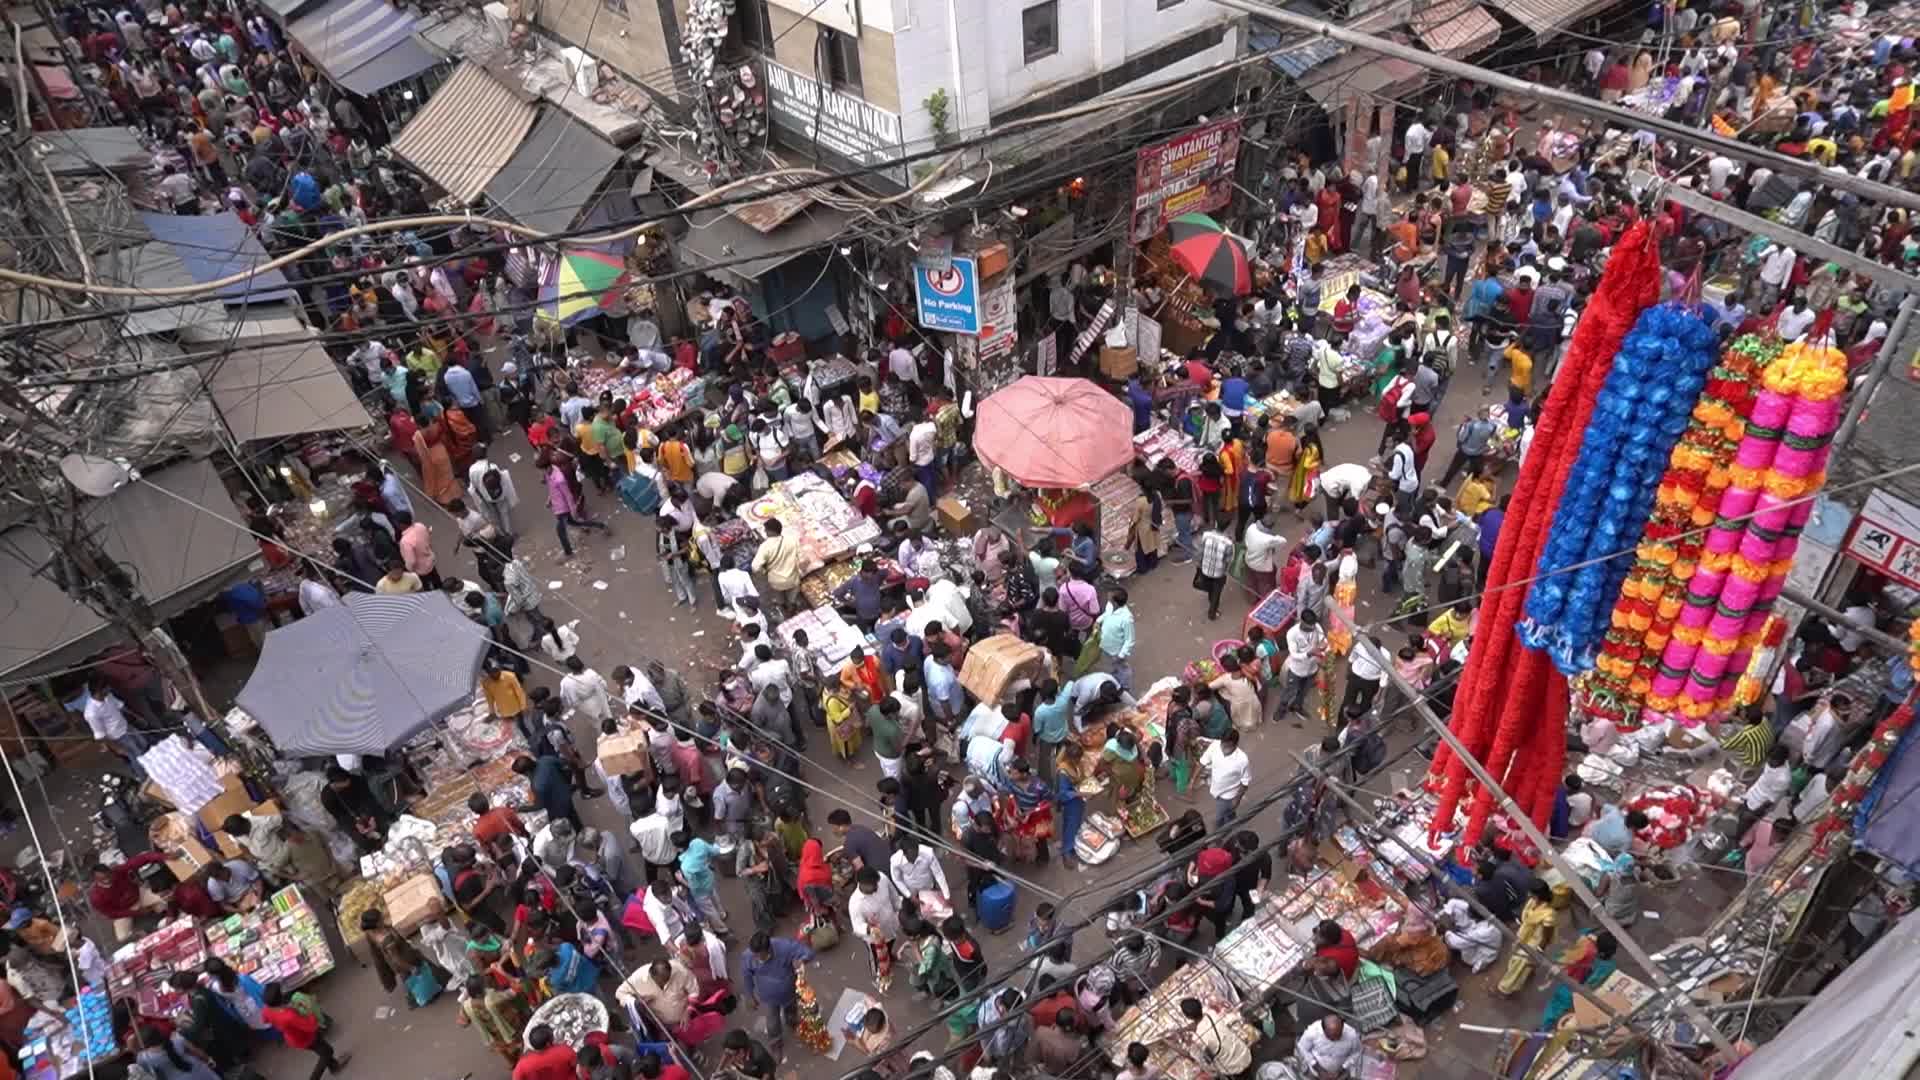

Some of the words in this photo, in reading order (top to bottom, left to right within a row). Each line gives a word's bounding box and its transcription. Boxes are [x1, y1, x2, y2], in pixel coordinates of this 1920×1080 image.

[768, 64, 793, 96] ANIL
[823, 88, 861, 129] RAKHI
[861, 105, 898, 145] WALA
[1161, 130, 1222, 165] SWATANTAR
[924, 298, 937, 308] No
[938, 300, 972, 314] Parking
